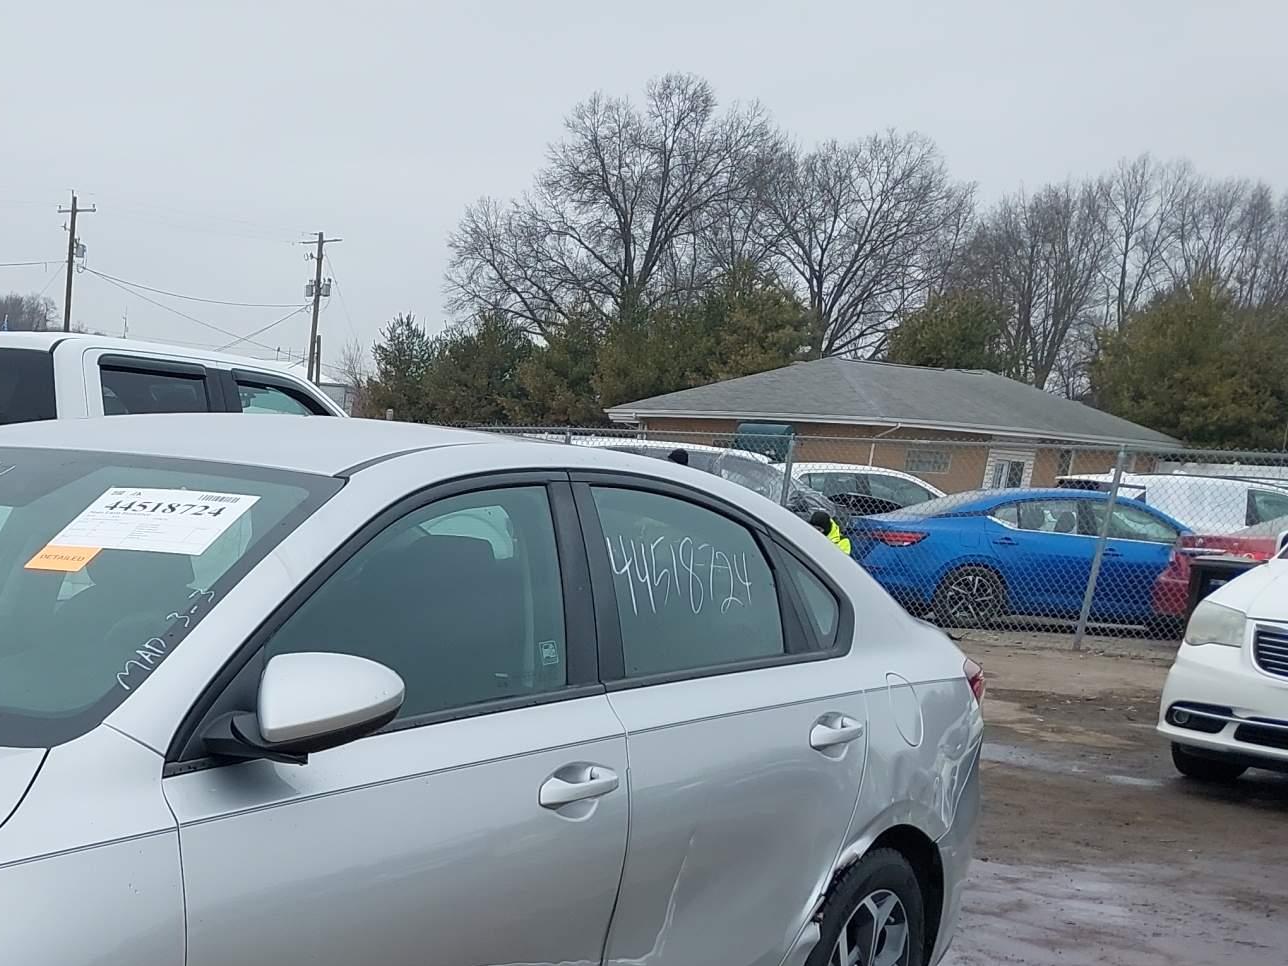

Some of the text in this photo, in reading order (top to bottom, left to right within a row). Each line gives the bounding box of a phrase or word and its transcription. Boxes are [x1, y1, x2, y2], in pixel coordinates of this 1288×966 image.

[105, 500, 226, 517] 44518724
[40, 553, 85, 562] DETAILED
[606, 535, 752, 616] 44518724
